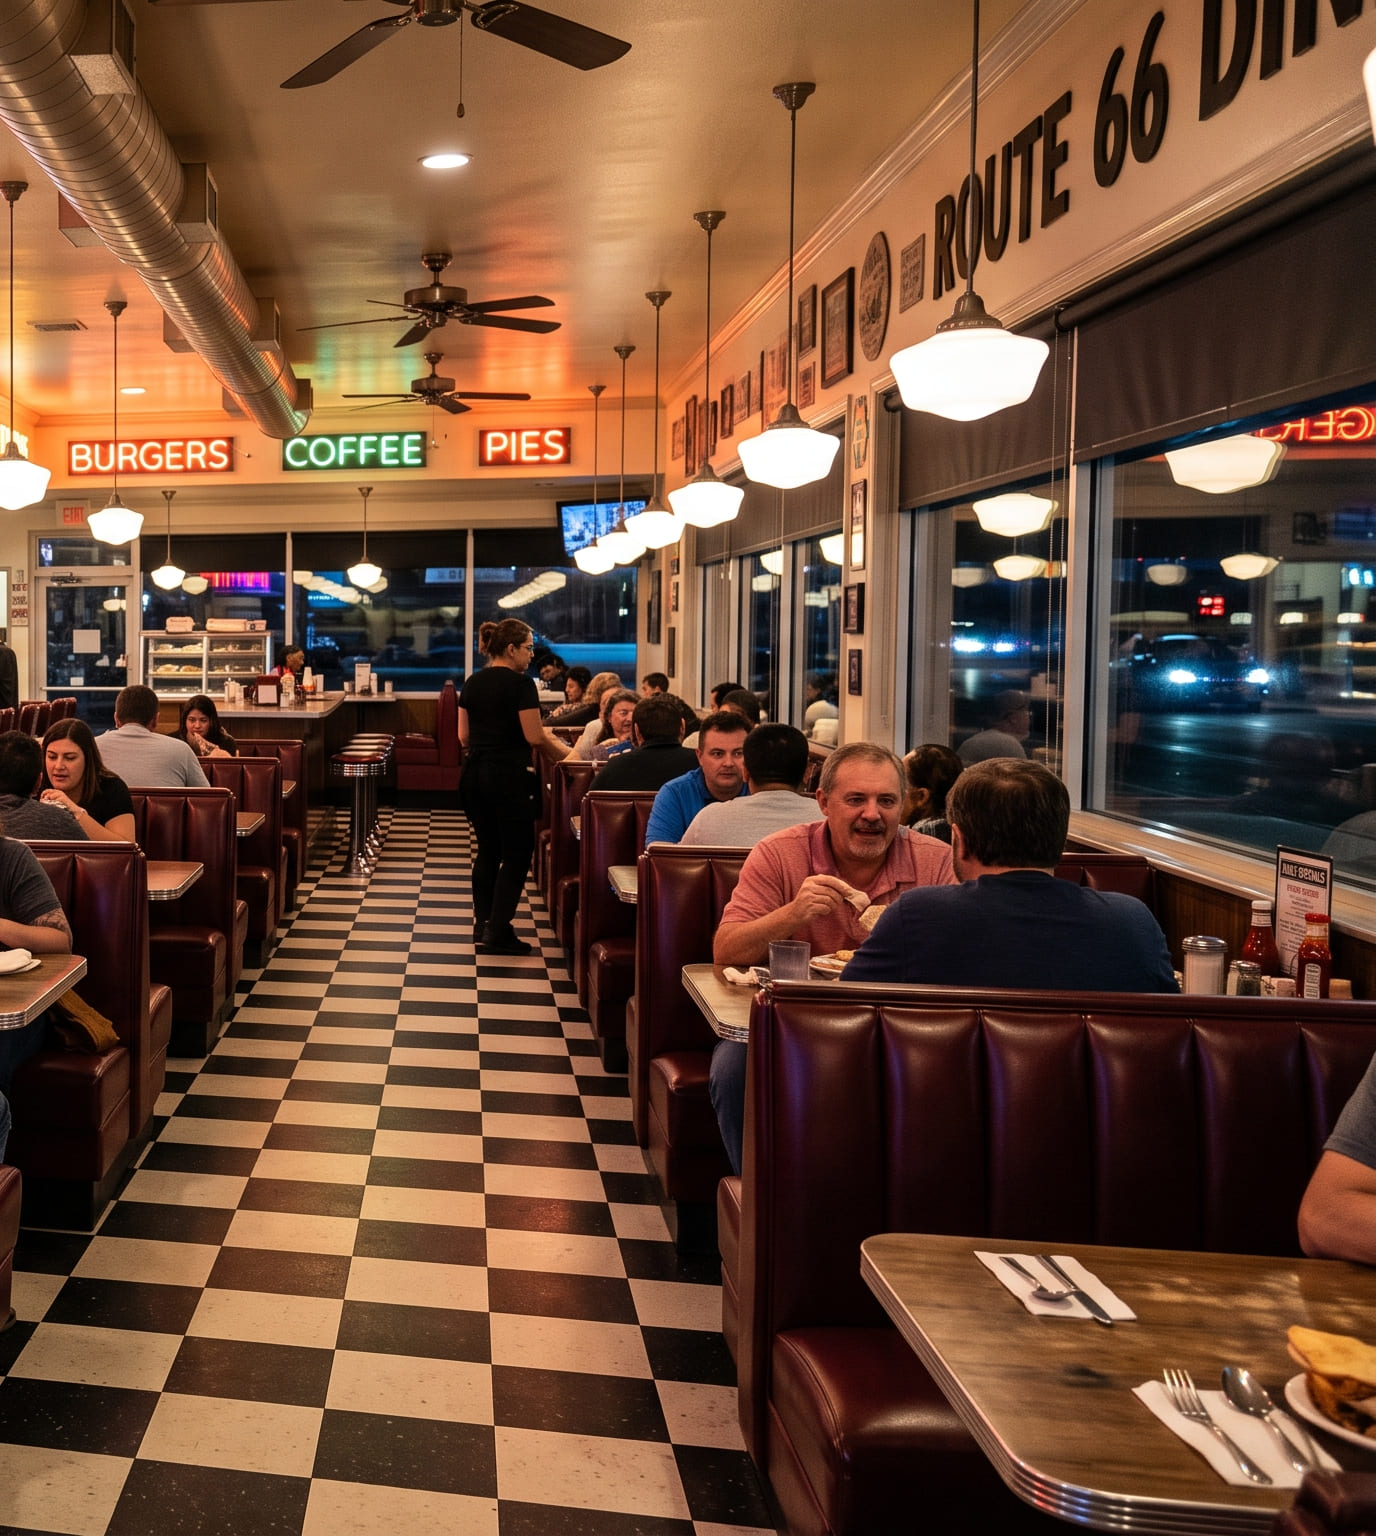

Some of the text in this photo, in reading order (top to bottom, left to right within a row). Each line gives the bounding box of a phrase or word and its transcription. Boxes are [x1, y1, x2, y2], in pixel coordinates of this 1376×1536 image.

[933, 90, 1072, 300] ROUTE
[1093, 10, 1170, 188] 66
[70, 439, 228, 473] BURGERS
[285, 434, 422, 467] COFFEE
[485, 429, 565, 463] PIES
